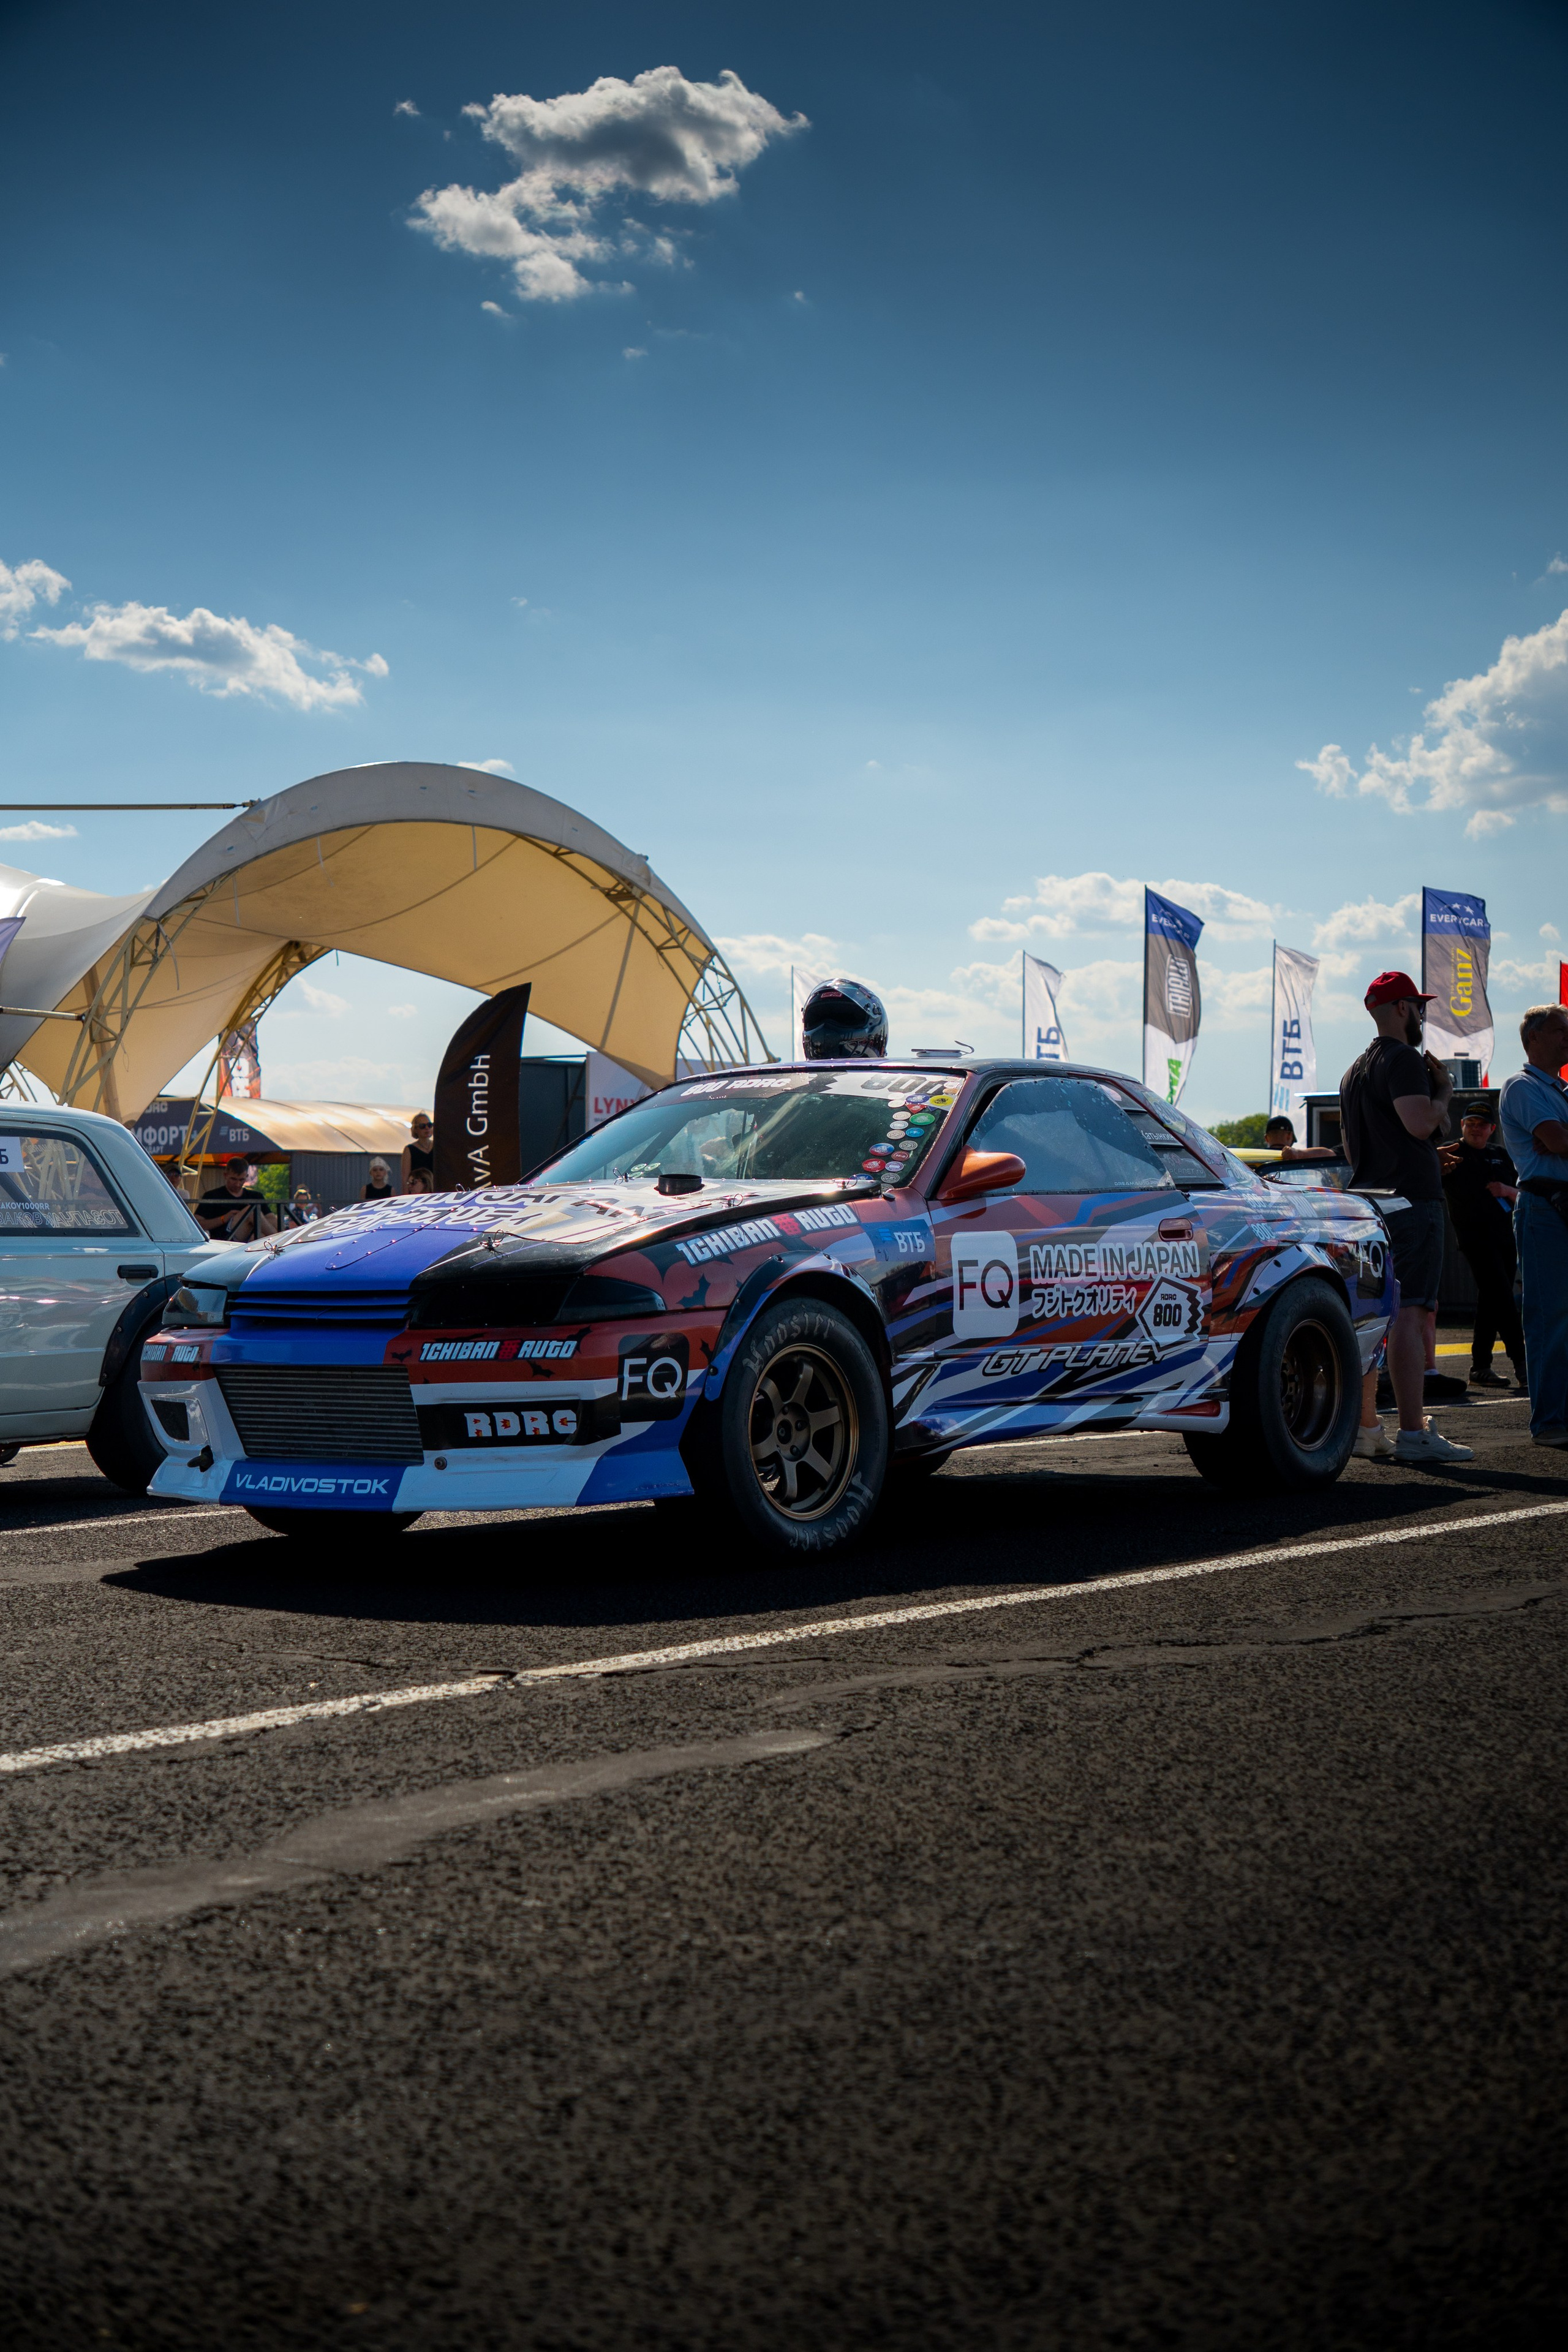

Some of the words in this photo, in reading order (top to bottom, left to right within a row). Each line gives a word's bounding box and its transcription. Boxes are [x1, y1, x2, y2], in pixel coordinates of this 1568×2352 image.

[1450, 948, 1472, 1017] Ganz
[1280, 1019, 1303, 1079] ВТБ
[467, 1055, 491, 1136] GmbH
[680, 1080, 729, 1097] 800
[229, 1128, 249, 1142] ВТБ
[0, 1202, 50, 1210] AKOV1000RR
[895, 1231, 925, 1253] ВТБ
[1032, 1247, 1097, 1279] MADE
[1102, 1247, 1123, 1276] IN
[1131, 1245, 1198, 1275] JAPAN
[1358, 1240, 1384, 1278] FQ
[957, 1259, 1015, 1311] FQ
[1153, 1303, 1182, 1327] 800
[621, 1357, 684, 1401] FQ
[464, 1409, 578, 1438] RDRC
[235, 1473, 390, 1494] VLADIVOSTOK
